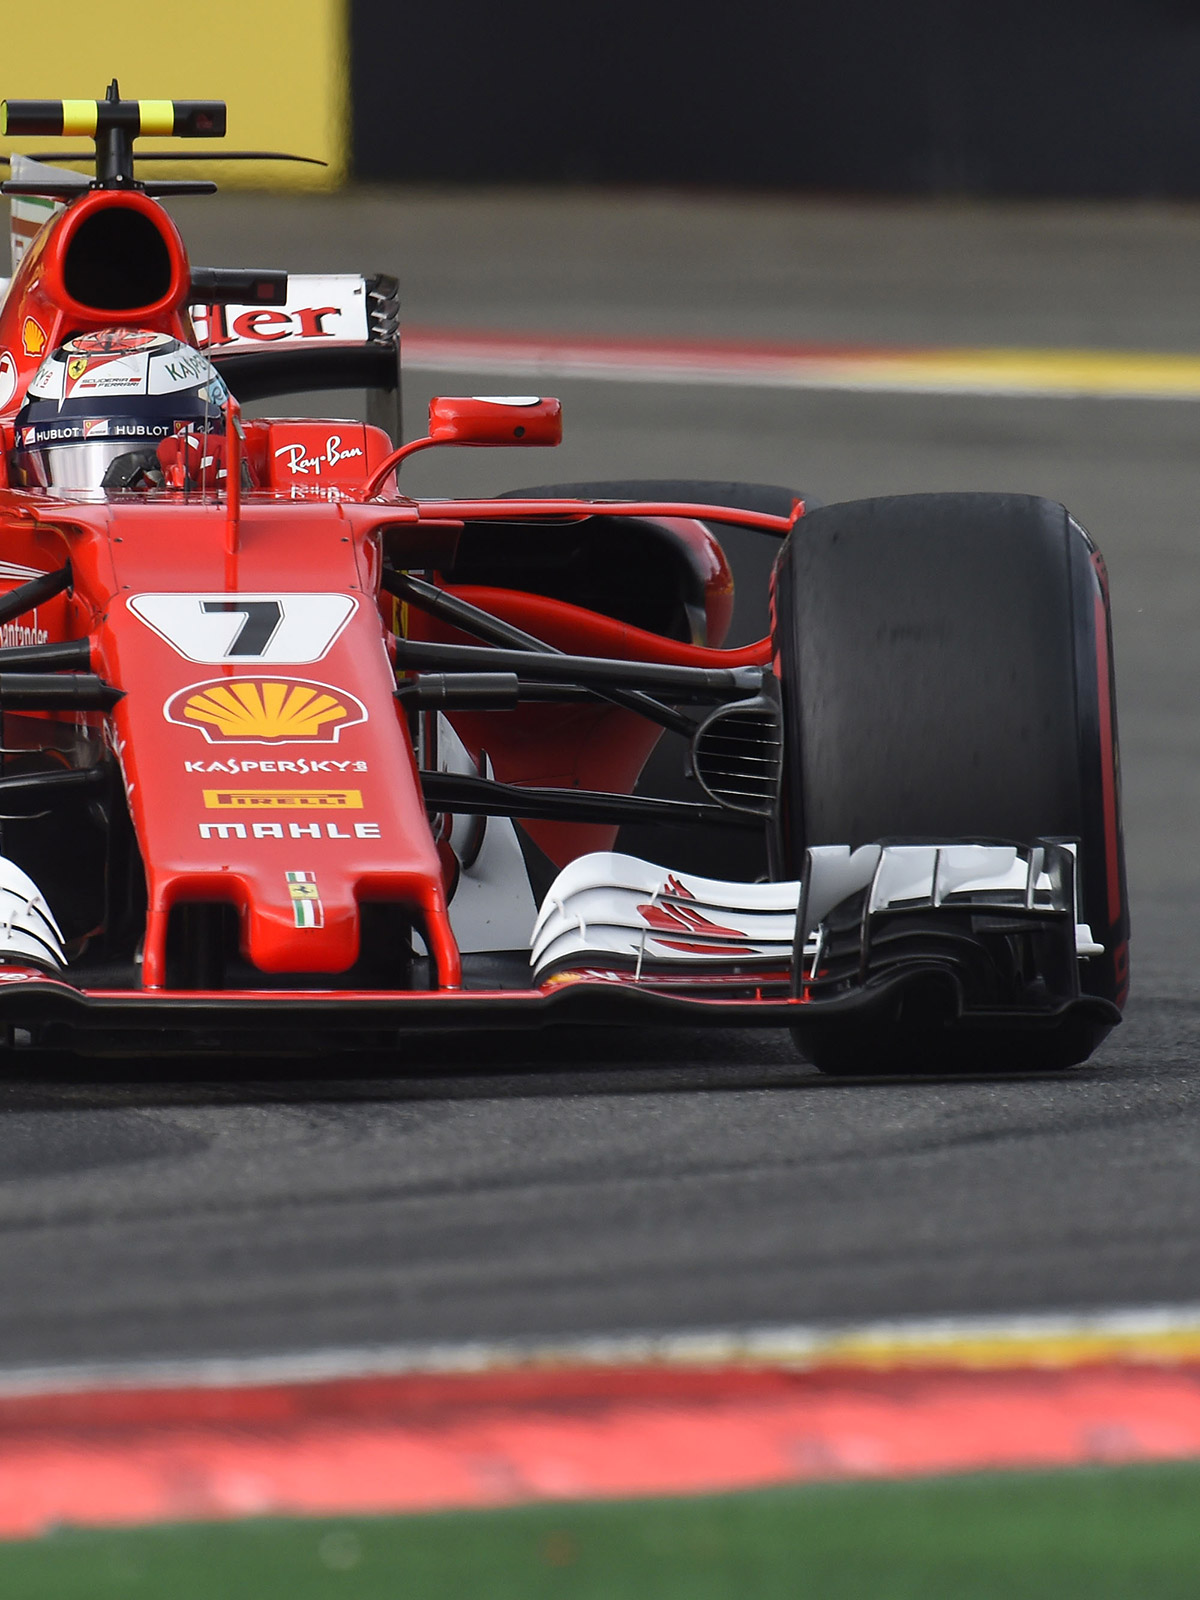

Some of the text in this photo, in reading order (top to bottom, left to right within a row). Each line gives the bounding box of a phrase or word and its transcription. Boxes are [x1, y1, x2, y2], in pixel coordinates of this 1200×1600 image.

[36, 427, 80, 442] HUBLOT
[115, 425, 169, 437] HUBLOT
[199, 601, 285, 658] 7
[184, 758, 351, 775] KASPERSKY
[217, 793, 347, 805] PIRELLI
[198, 823, 382, 839] MAHLE
